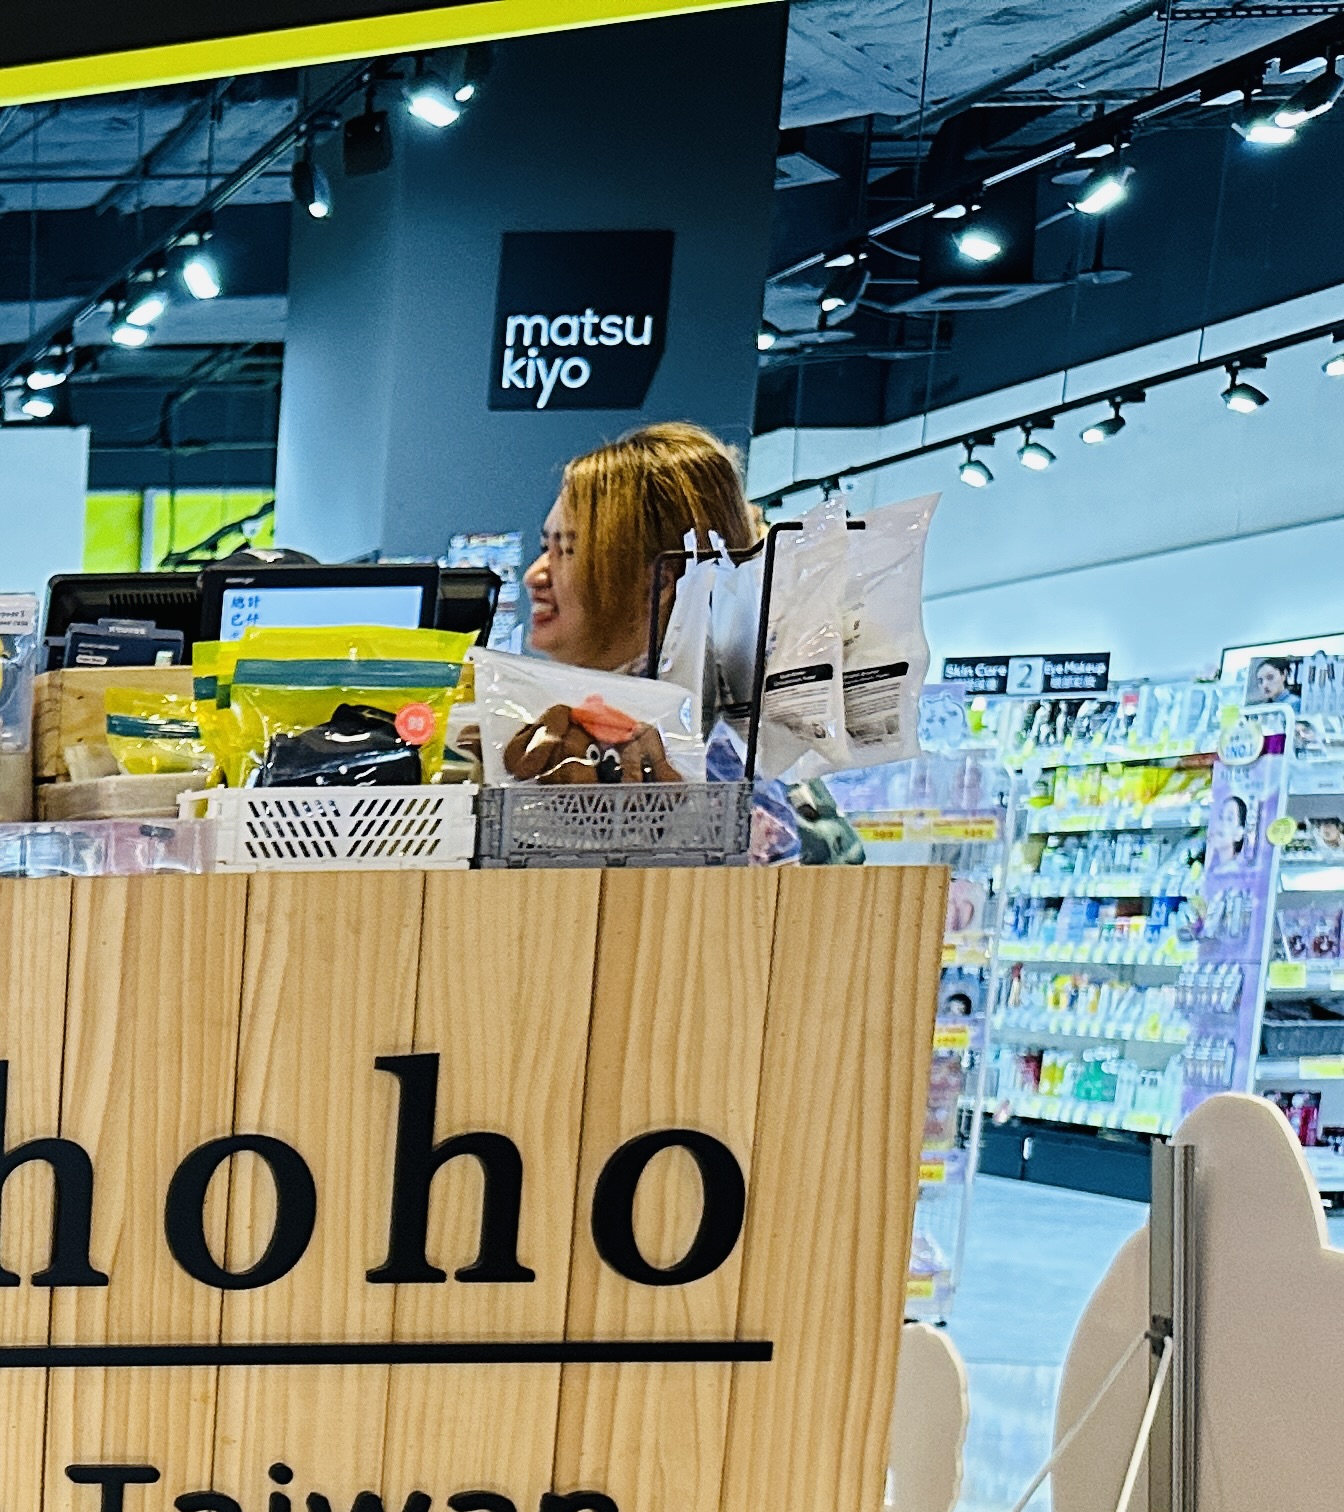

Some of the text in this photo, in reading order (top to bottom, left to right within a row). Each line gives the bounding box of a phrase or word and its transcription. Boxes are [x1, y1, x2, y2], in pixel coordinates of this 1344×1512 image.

[505, 308, 653, 346] matsu
[502, 347, 591, 409] kiyo
[1016, 663, 1034, 689] 2
